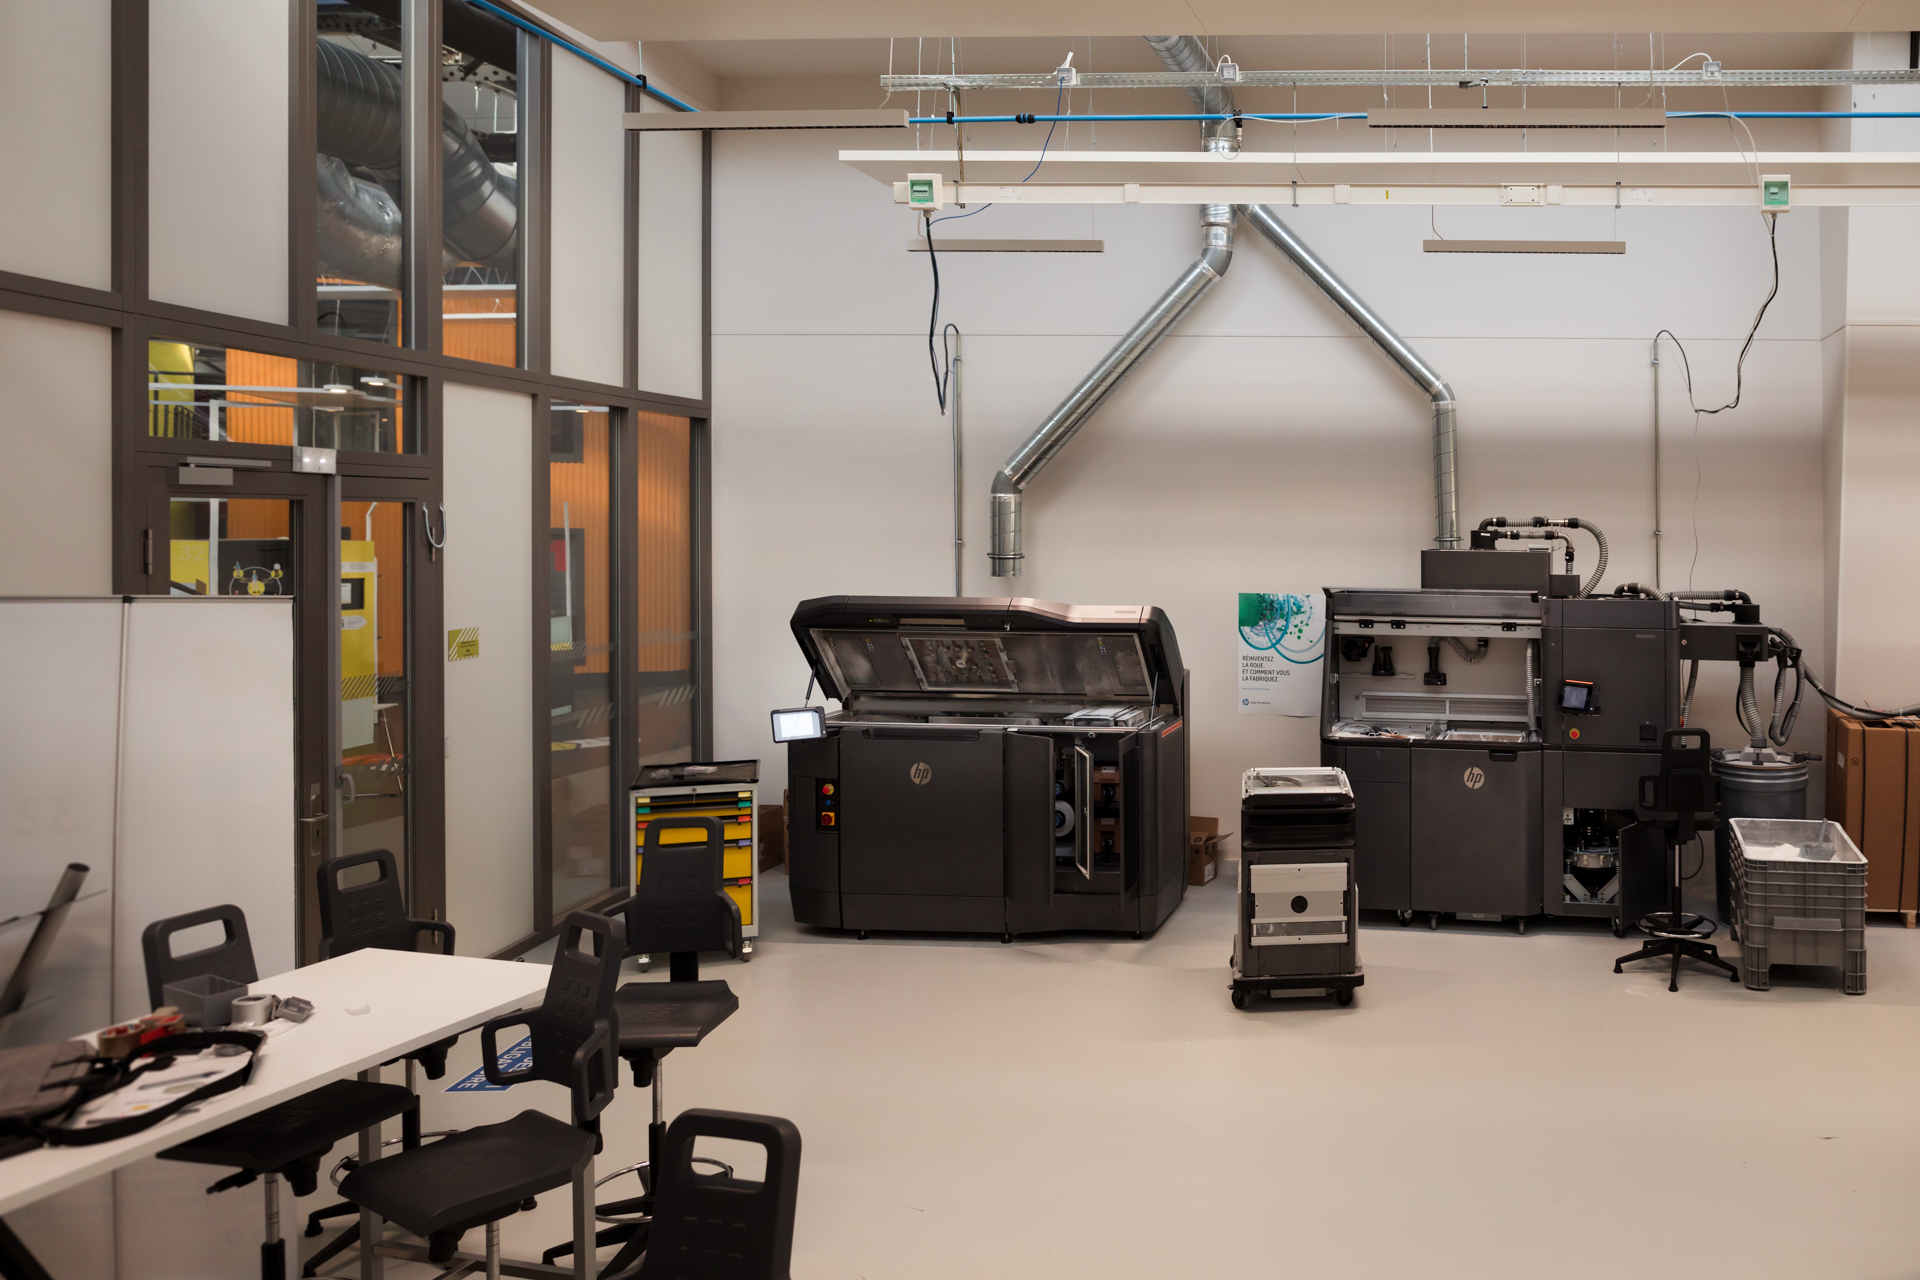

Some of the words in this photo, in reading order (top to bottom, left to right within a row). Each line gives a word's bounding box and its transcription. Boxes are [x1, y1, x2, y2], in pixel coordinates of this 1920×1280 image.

[179, 545, 205, 561] 32
[911, 762, 931, 785] hp
[1465, 766, 1484, 789] hp
